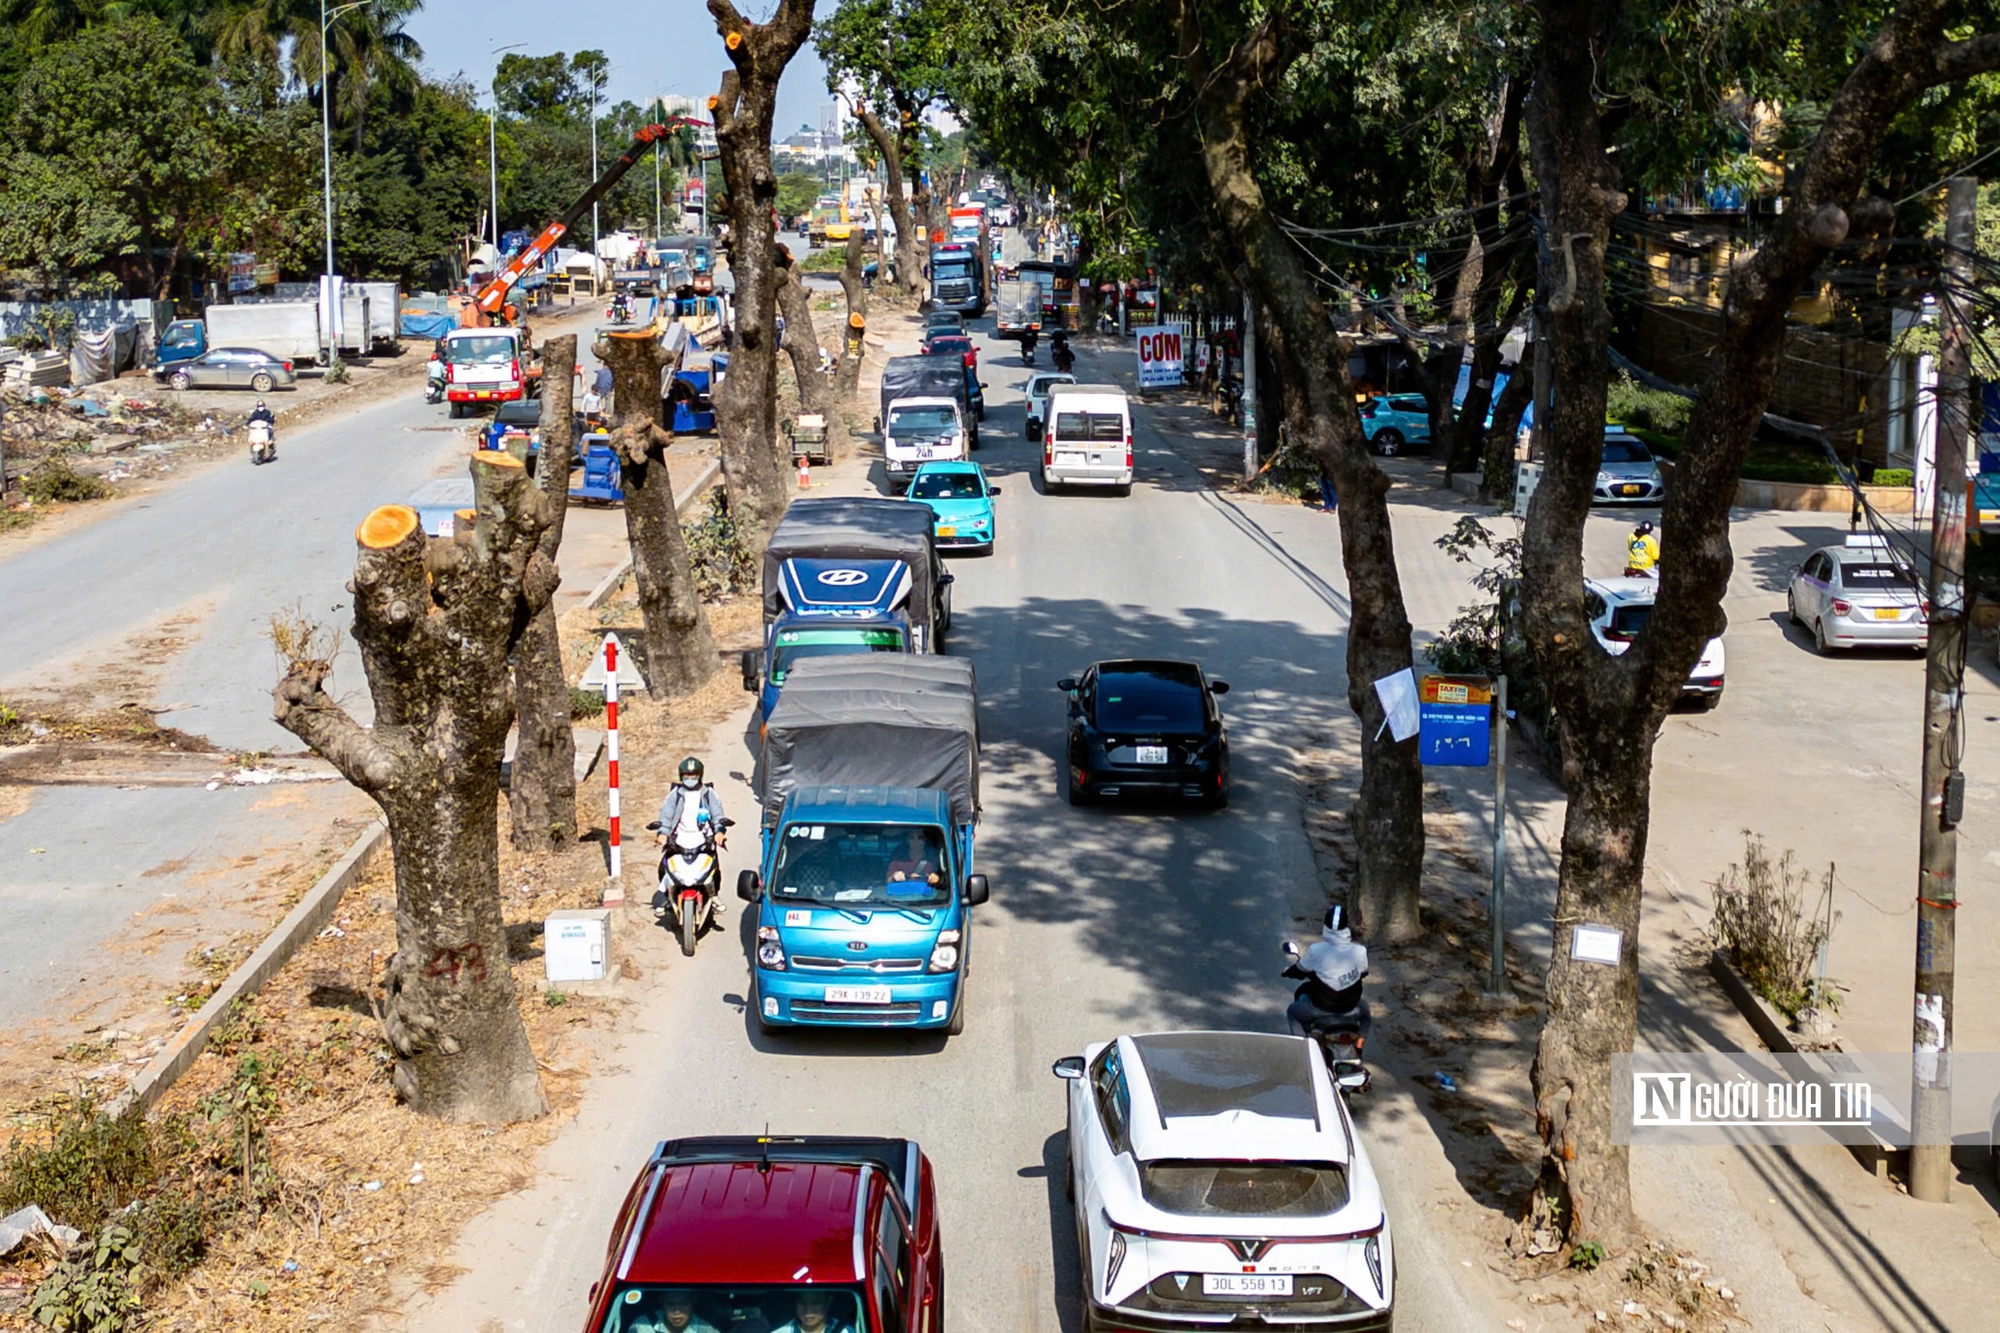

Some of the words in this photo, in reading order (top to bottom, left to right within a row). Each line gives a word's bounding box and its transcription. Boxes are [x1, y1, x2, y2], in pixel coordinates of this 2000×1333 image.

[1140, 331, 1182, 363] CƠM
[916, 447, 933, 458] 24h
[850, 942, 866, 950] KIA
[874, 991, 886, 1000] 22
[1212, 1277, 1235, 1290] 30L
[1271, 1278, 1285, 1291] 13
